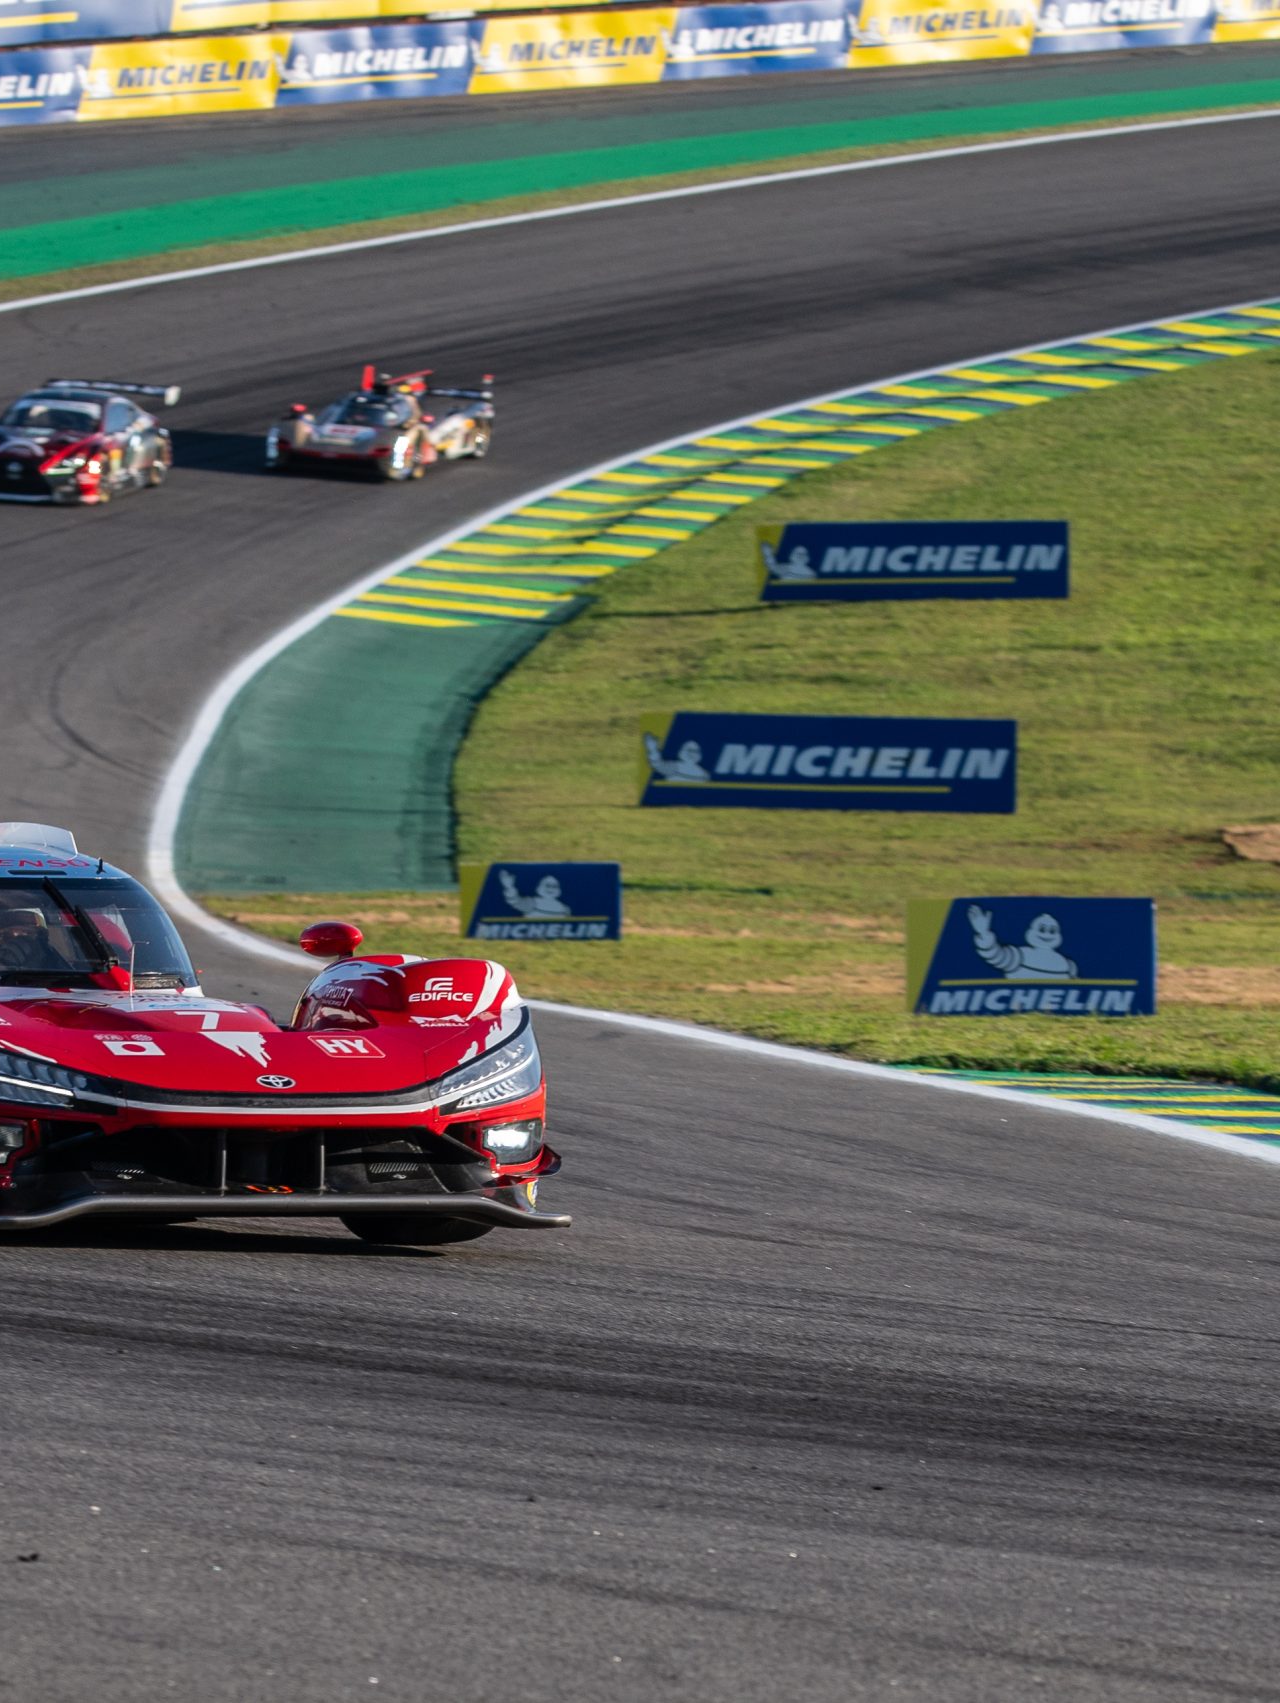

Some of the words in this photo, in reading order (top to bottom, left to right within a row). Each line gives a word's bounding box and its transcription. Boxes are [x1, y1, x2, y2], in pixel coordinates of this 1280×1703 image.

[693, 19, 846, 51] MICHELIN
[888, 7, 1024, 35] MICHELIN
[313, 44, 468, 77] MICHELIN
[509, 36, 657, 62] MICHELIN
[118, 60, 270, 88] MICHELIN
[821, 544, 1065, 573] MICHELIN
[714, 743, 1010, 779] MICHELIN
[474, 923, 609, 941] MICHELIN
[408, 991, 474, 1003] EDIFICE
[929, 988, 1135, 1013] MICHELIN
[316, 1038, 370, 1054] HY
